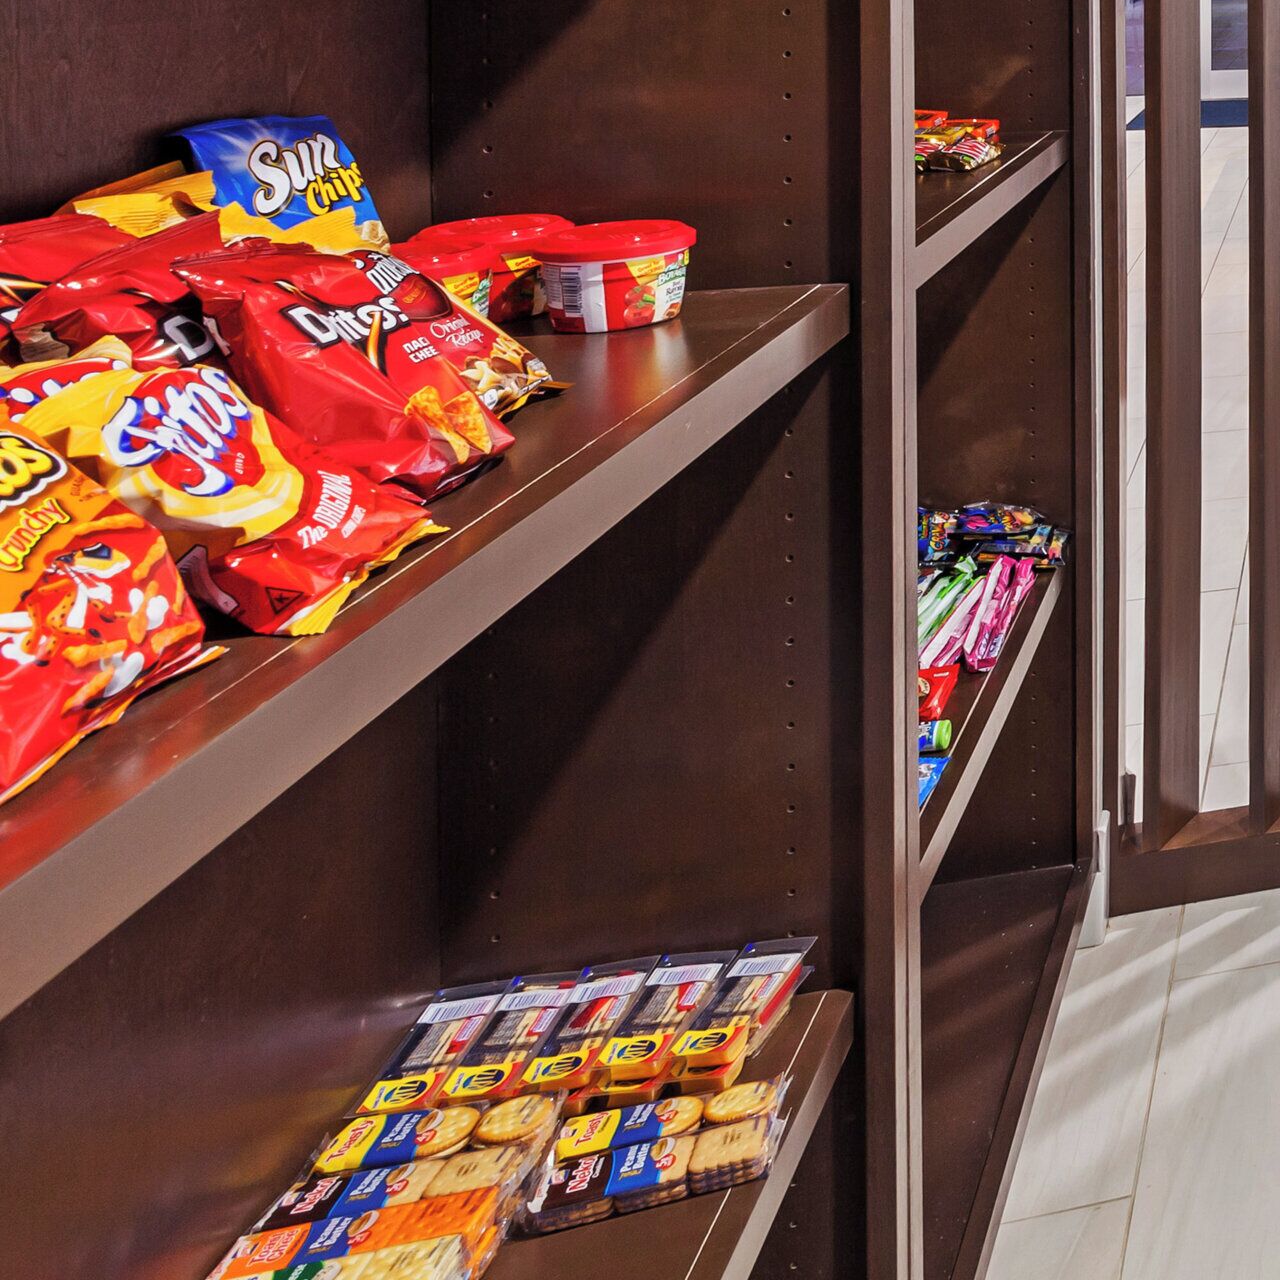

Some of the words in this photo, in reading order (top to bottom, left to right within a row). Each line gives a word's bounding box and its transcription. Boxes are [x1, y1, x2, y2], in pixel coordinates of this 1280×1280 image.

[249, 133, 342, 216] Sun
[103, 368, 251, 497] Fritos
[298, 525, 329, 550] The
[326, 1121, 373, 1162] Toasty
[575, 1111, 610, 1147] Toasty
